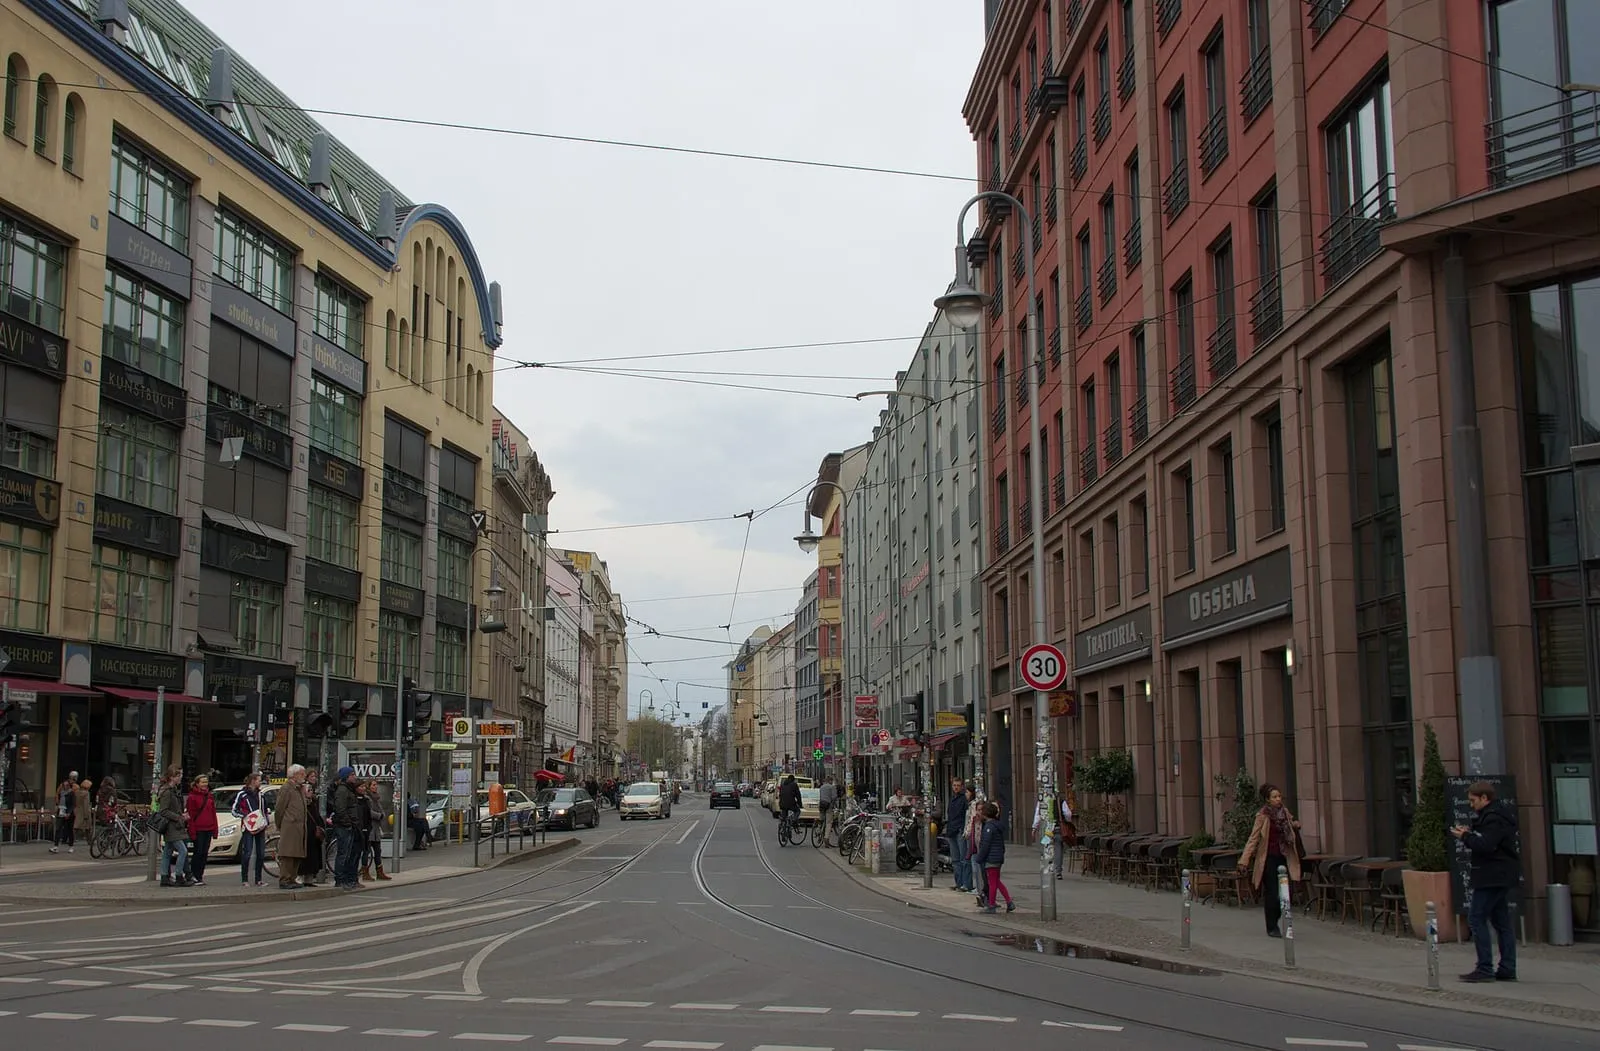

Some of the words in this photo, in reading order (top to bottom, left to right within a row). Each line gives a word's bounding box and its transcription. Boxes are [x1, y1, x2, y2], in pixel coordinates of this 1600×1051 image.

[128, 236, 172, 272] trippen
[227, 303, 254, 328] studio
[262, 316, 279, 342] funk
[1189, 574, 1257, 621] OSSENA
[32, 649, 54, 664] HOF
[1086, 621, 1138, 658] TRATTORIA
[101, 658, 159, 677] HACKESCHER
[160, 665, 177, 679] HOF
[1031, 657, 1056, 677] 30
